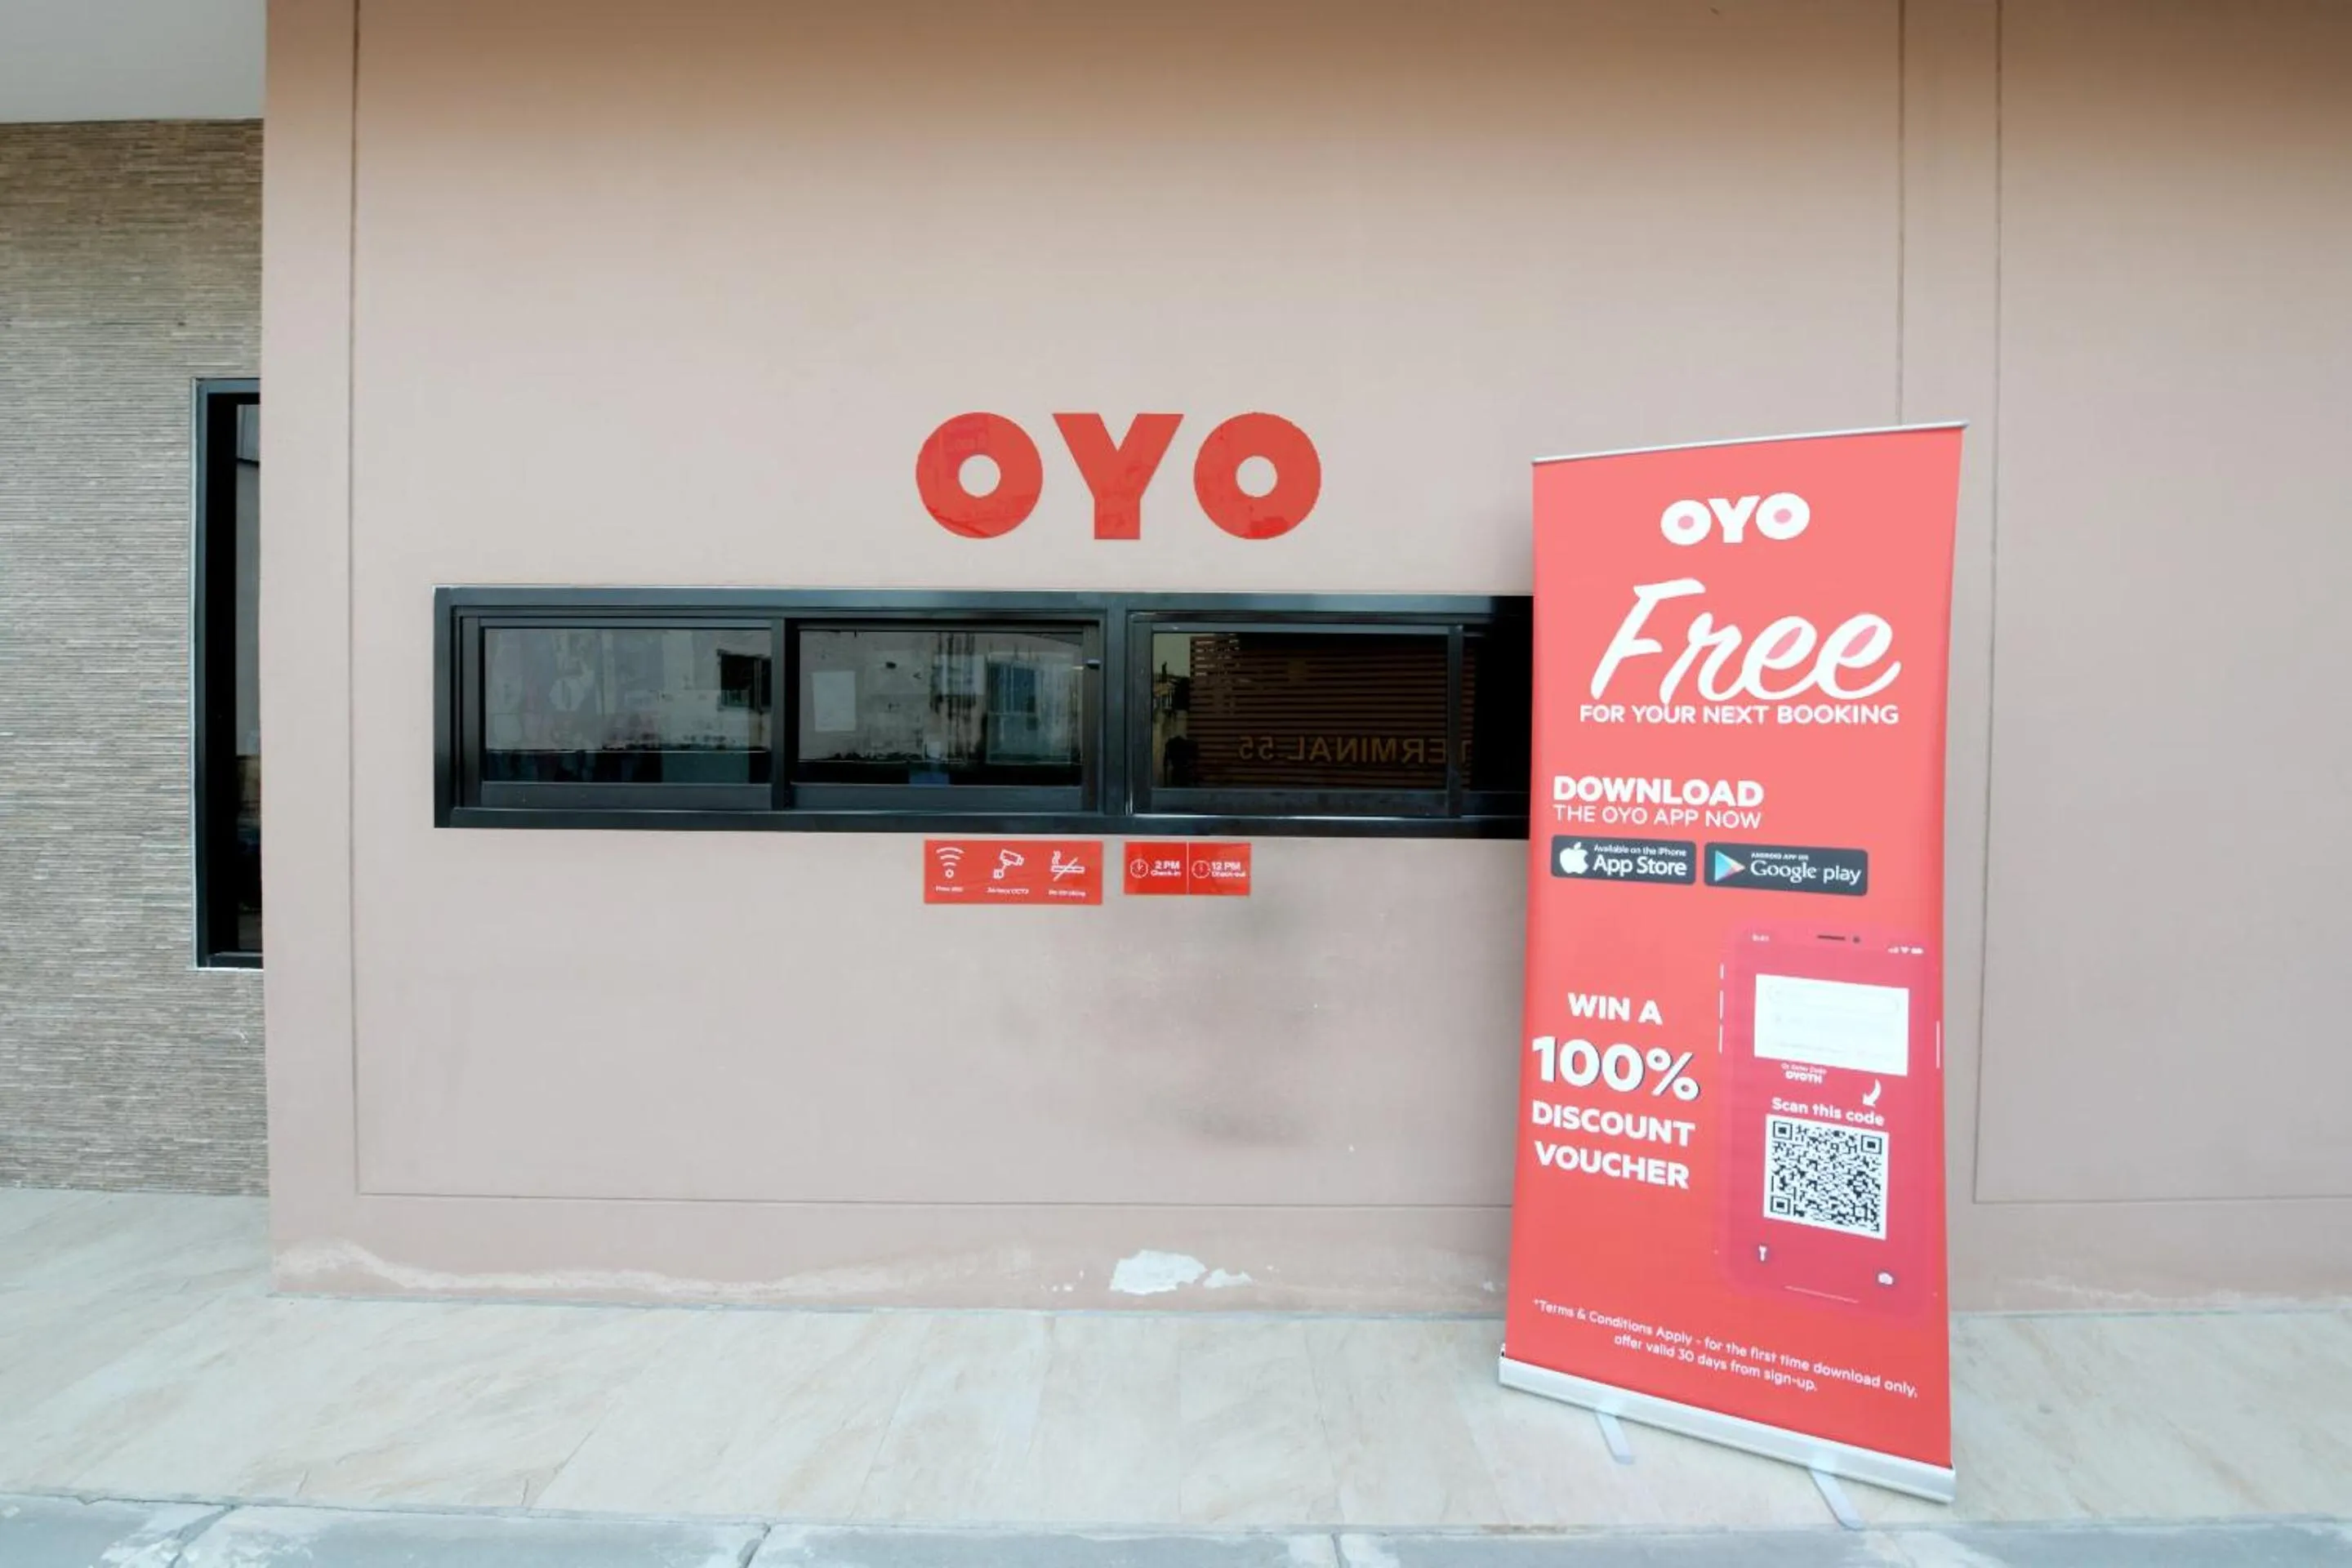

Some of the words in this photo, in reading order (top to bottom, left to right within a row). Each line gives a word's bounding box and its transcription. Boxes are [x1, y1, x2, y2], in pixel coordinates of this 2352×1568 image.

[915, 412, 1321, 540] OYO
[1660, 492, 1811, 546] OYO
[1590, 577, 1901, 704] Free
[1579, 705, 1624, 724] FOR
[1632, 704, 1696, 724] YOUR
[1702, 705, 1769, 724] NEXT
[1777, 704, 1899, 725] BOOKING
[1552, 776, 1764, 807] DOWNLOAD
[1553, 804, 1595, 823] THE
[1601, 807, 1648, 826] OYO
[1653, 808, 1699, 827] APP
[1705, 810, 1762, 829] NOW
[1155, 861, 1162, 870] 2
[1164, 861, 1180, 870] PM
[1224, 862, 1241, 871] PM
[1593, 844, 1629, 855] Available
[1642, 846, 1656, 856] the
[1658, 847, 1687, 858] iPhone
[1593, 855, 1633, 876] App
[1637, 857, 1688, 875] Store
[1751, 860, 1817, 883] Google
[1824, 859, 1862, 885] play
[1568, 992, 1630, 1022] WIN
[1637, 1000, 1663, 1025] A
[1532, 1036, 1701, 1102] 100%
[1785, 1070, 1823, 1085] OYOTH
[1532, 1100, 1696, 1147] DISCOUNT
[1771, 1097, 1808, 1115] Scan
[1812, 1102, 1842, 1119] this
[1846, 1109, 1885, 1127] code
[1535, 1140, 1690, 1190] VOUCHER
[1576, 1307, 1587, 1321] &
[1588, 1311, 1653, 1335] Conditions
[1656, 1326, 1692, 1346] Apply
[1704, 1336, 1723, 1351] for
[1726, 1341, 1747, 1357] the
[1750, 1346, 1777, 1363] first
[1780, 1353, 1810, 1372] time
[1813, 1361, 1881, 1388] download
[1615, 1334, 1642, 1351] offer
[1646, 1340, 1675, 1358] valid
[1677, 1348, 1695, 1363] 30
[1698, 1352, 1726, 1371] days
[1731, 1360, 1761, 1379] from
[1764, 1368, 1817, 1392] sign-up.
